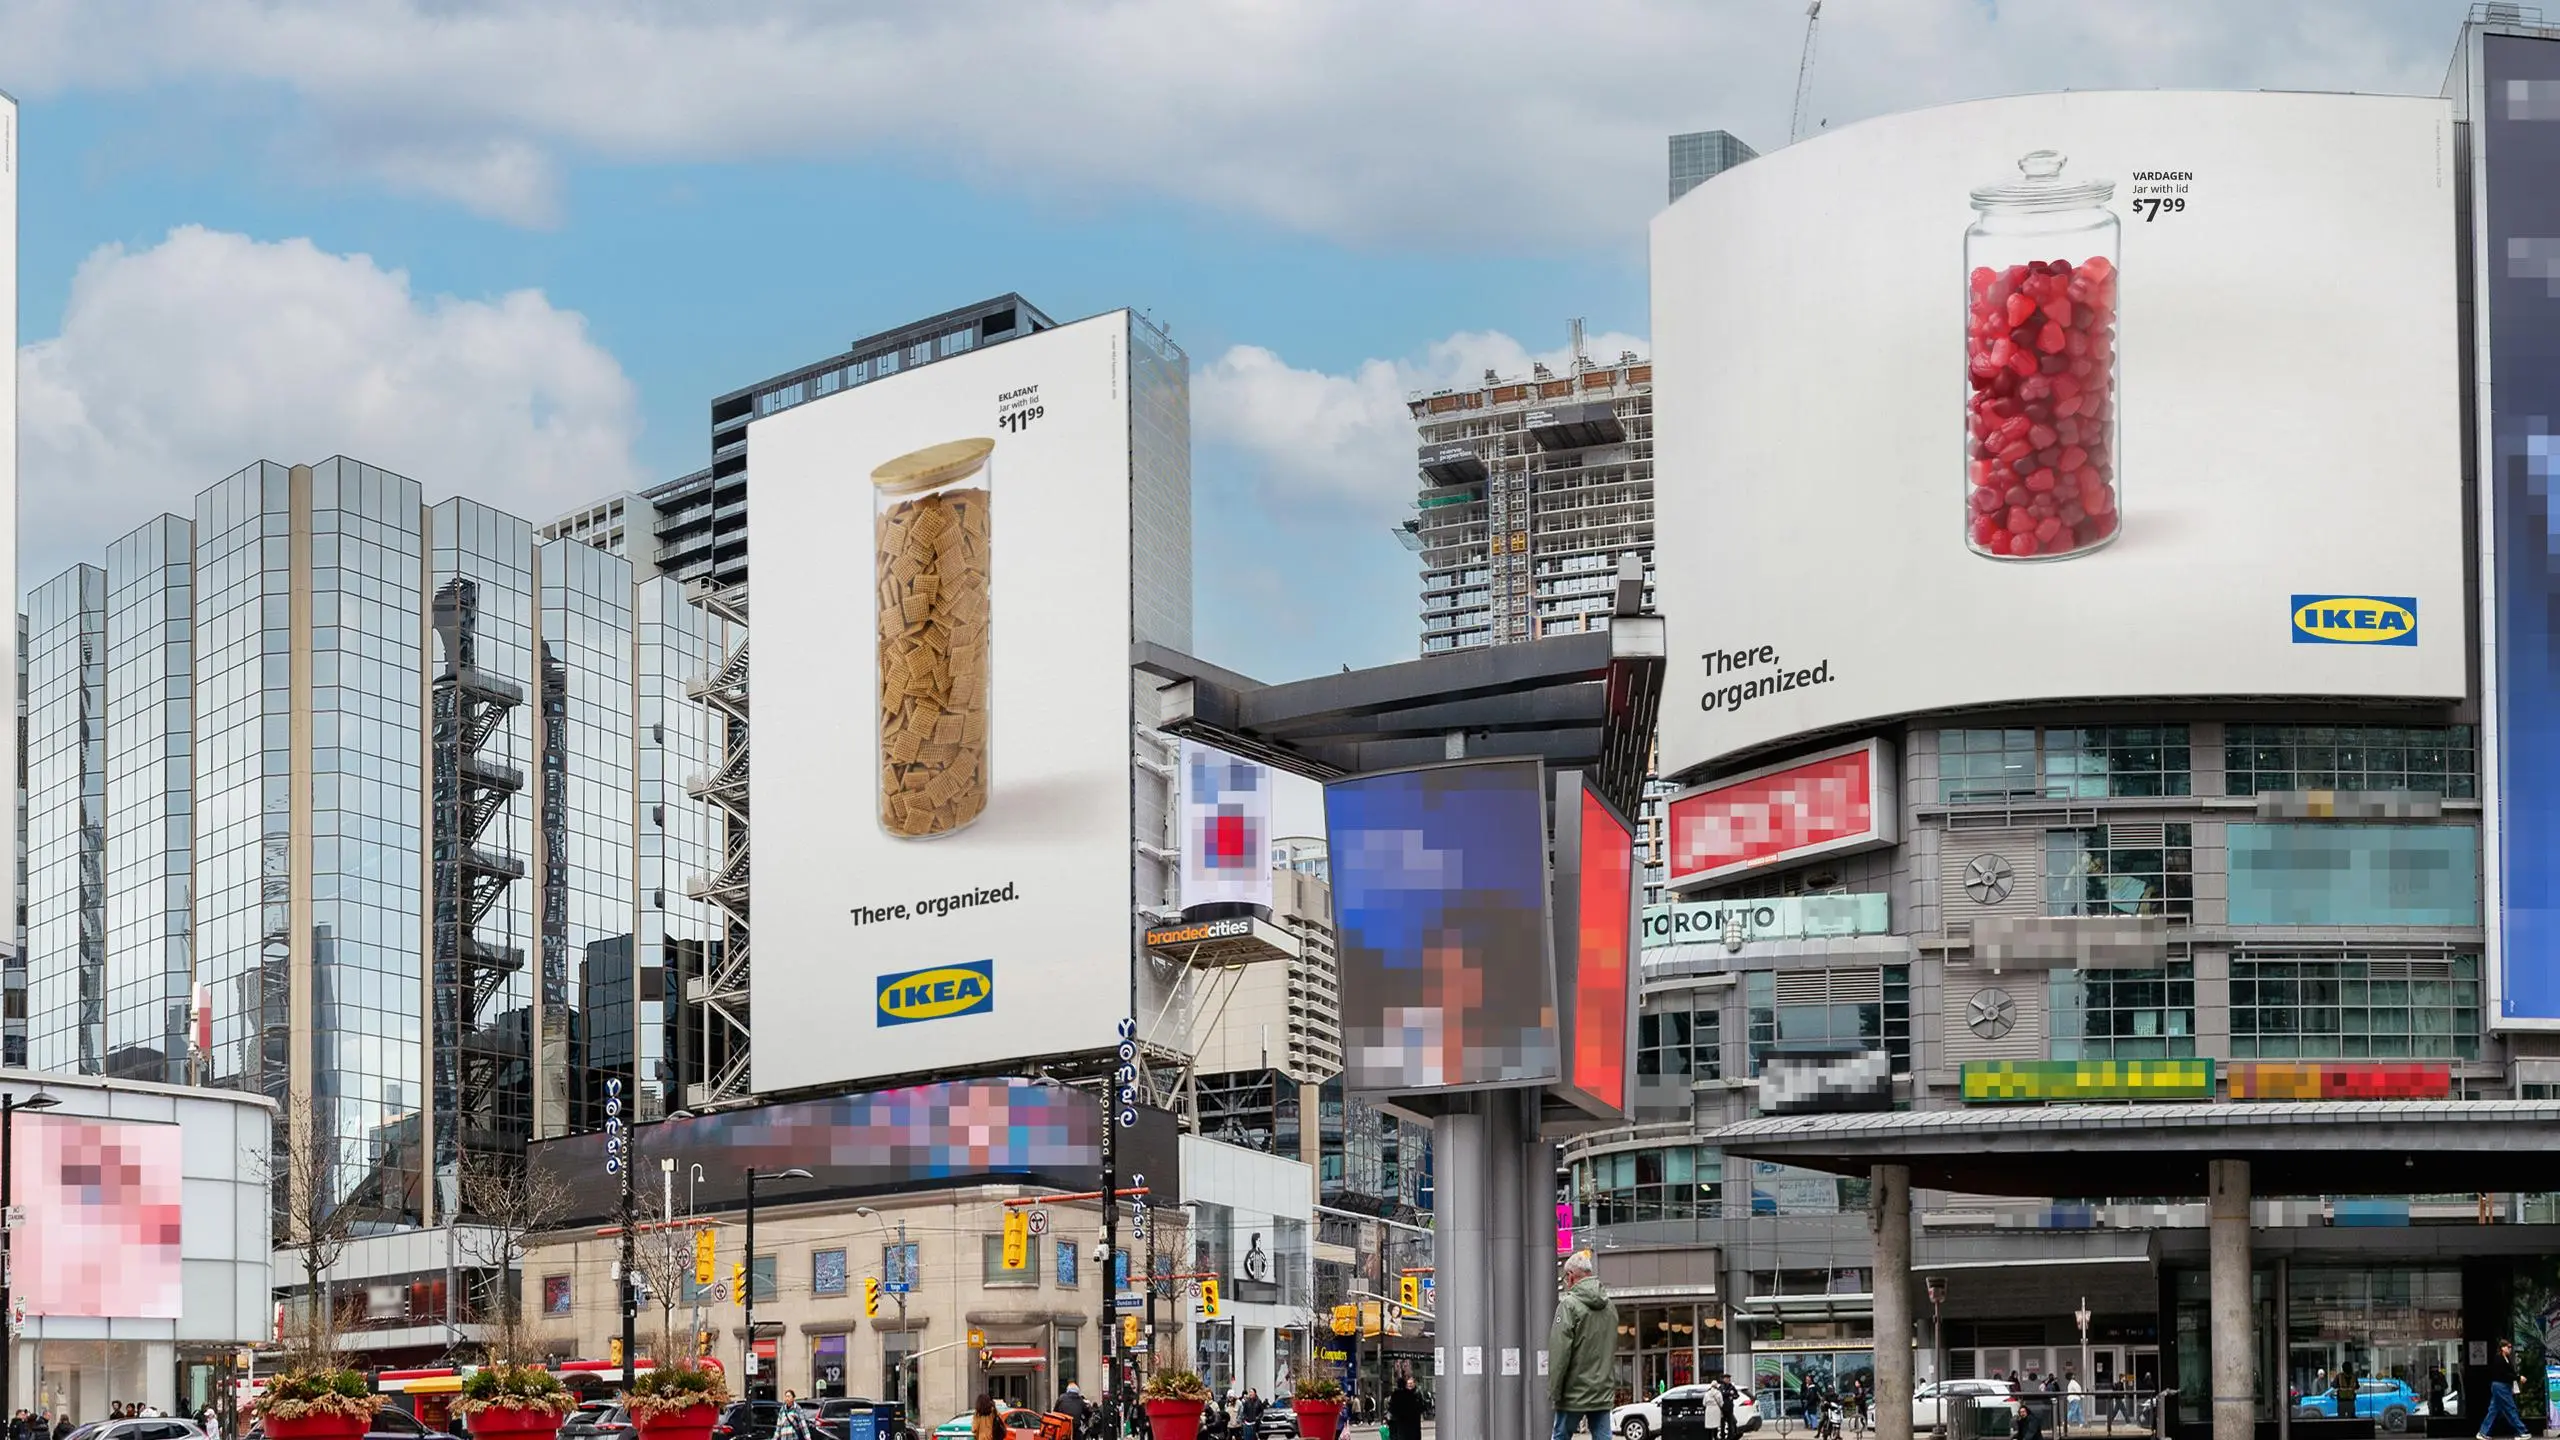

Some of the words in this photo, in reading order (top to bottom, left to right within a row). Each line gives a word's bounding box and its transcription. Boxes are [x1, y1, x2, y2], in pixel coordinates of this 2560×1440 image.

[2132, 171, 2193, 181] VARDAGEN
[2132, 184, 2148, 194] Jar
[2150, 183, 2173, 194] with
[2176, 183, 2189, 194] lid
[998, 384, 1039, 402] EKLATANT
[999, 404, 1010, 413] Jar
[1011, 398, 1028, 409] with
[1030, 395, 1039, 405] lid
[2304, 608, 2408, 631] IKEA
[1701, 644, 1780, 677] There,
[1700, 658, 1836, 712] organized.
[850, 905, 911, 927] There,
[915, 881, 1020, 918] organized.
[1146, 920, 1249, 946] brandedcities
[1642, 906, 1776, 938] TORONTO
[888, 976, 984, 1010] IKEA
[1117, 1017, 1139, 1129] Yonge
[605, 1078, 623, 1175] Yonge
[1102, 1077, 1110, 1156] DOWNTOWN
[1320, 1346, 1347, 1363] Computers
[826, 1367, 841, 1381] 19
